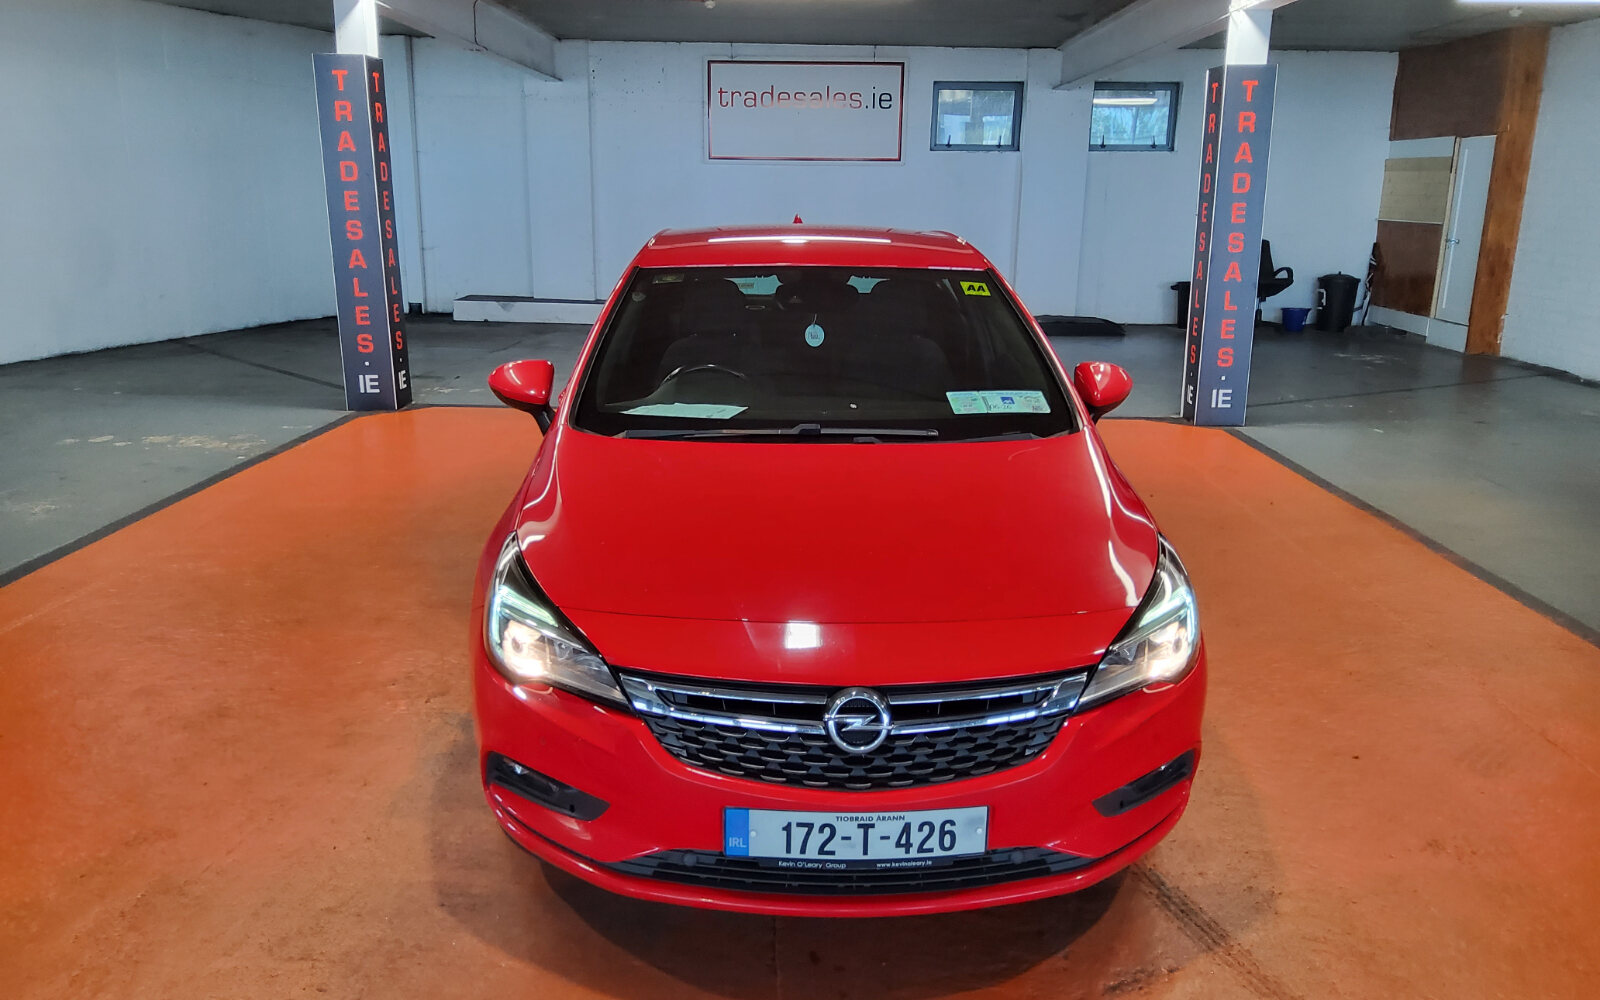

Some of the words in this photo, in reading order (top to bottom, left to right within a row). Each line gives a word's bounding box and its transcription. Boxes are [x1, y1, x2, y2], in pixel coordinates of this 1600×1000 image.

[718, 85, 892, 110] tradesales.ie
[967, 284, 985, 292] AA
[729, 837, 747, 848] IRL
[781, 819, 957, 856] 172-T-426
[797, 861, 823, 869] O'Leary
